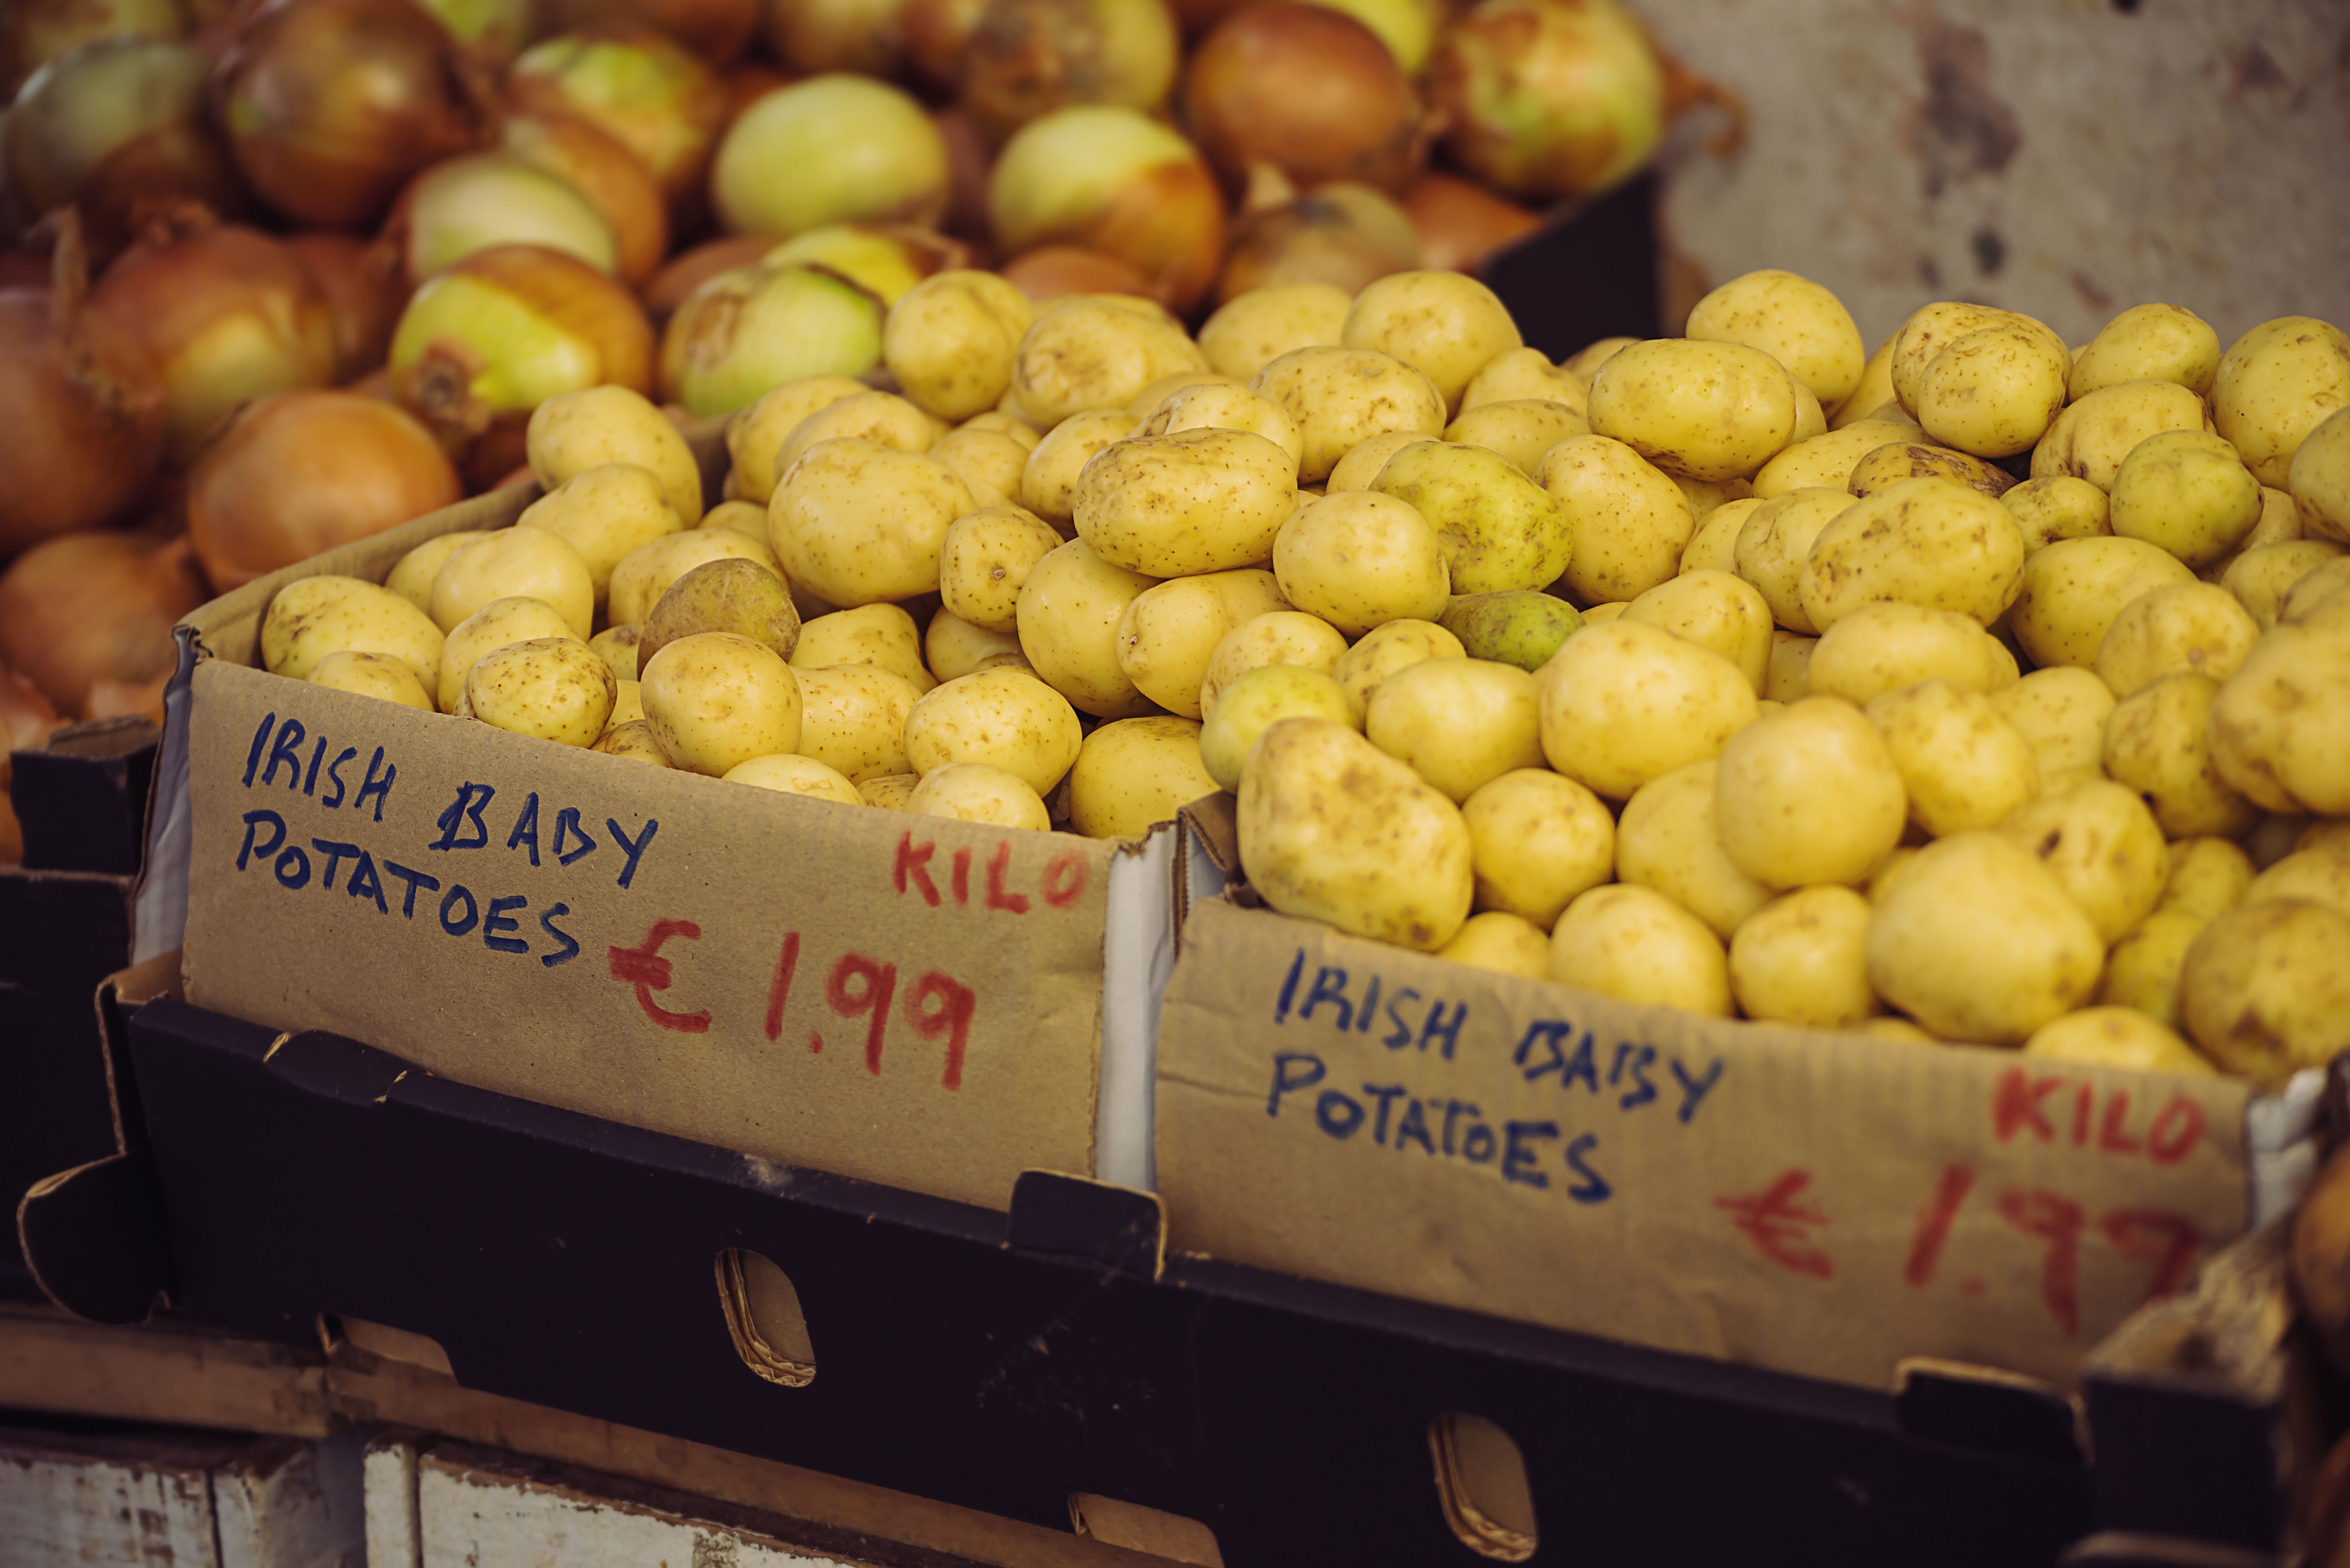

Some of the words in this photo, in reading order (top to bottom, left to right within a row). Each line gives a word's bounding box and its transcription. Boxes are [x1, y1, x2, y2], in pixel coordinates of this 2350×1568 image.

[242, 711, 397, 823] IRISH
[429, 781, 659, 890] BABY
[892, 828, 1089, 915] KILO
[236, 809, 580, 967] POTATOES
[1274, 947, 1467, 1060] IRISH
[1513, 1020, 1725, 1124] BABY
[1266, 1052, 1613, 1204] POTATOES
[1989, 1066, 2207, 1166] KILO
